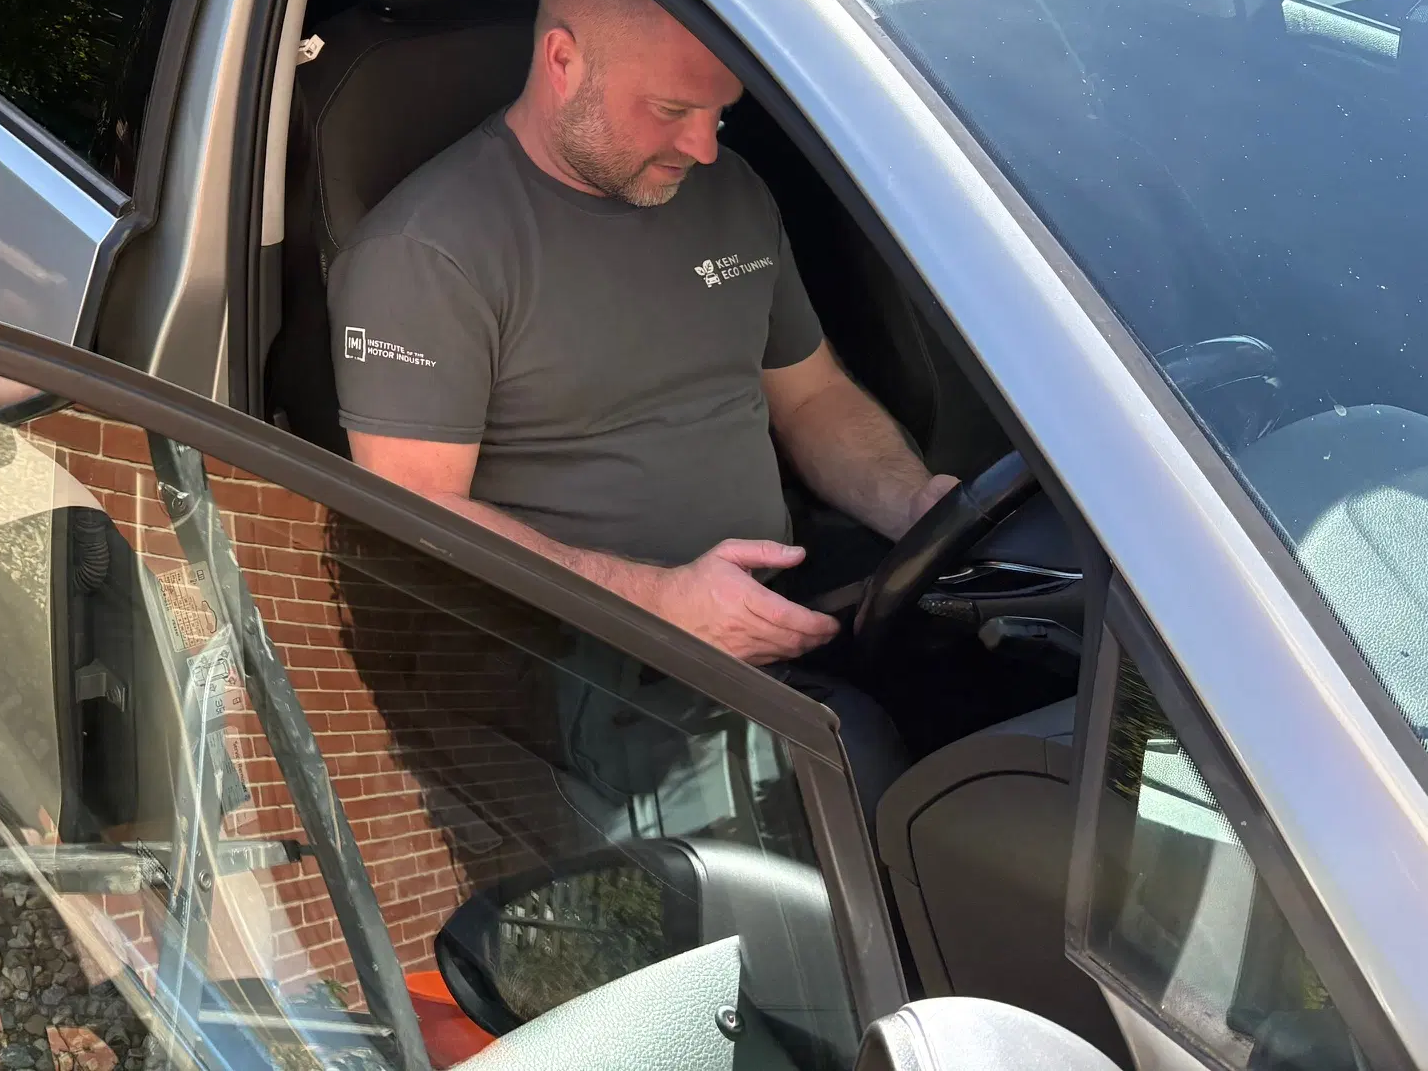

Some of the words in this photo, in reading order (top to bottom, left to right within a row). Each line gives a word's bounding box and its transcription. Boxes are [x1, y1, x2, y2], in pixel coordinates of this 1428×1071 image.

[715, 254, 739, 269] KENT
[721, 266, 740, 280] ECO
[739, 256, 774, 274] TUNING
[348, 336, 362, 350] IMI
[367, 339, 405, 354] INSTITUTE
[367, 347, 394, 359] MOTOR
[396, 353, 436, 367] INDUSTRY
